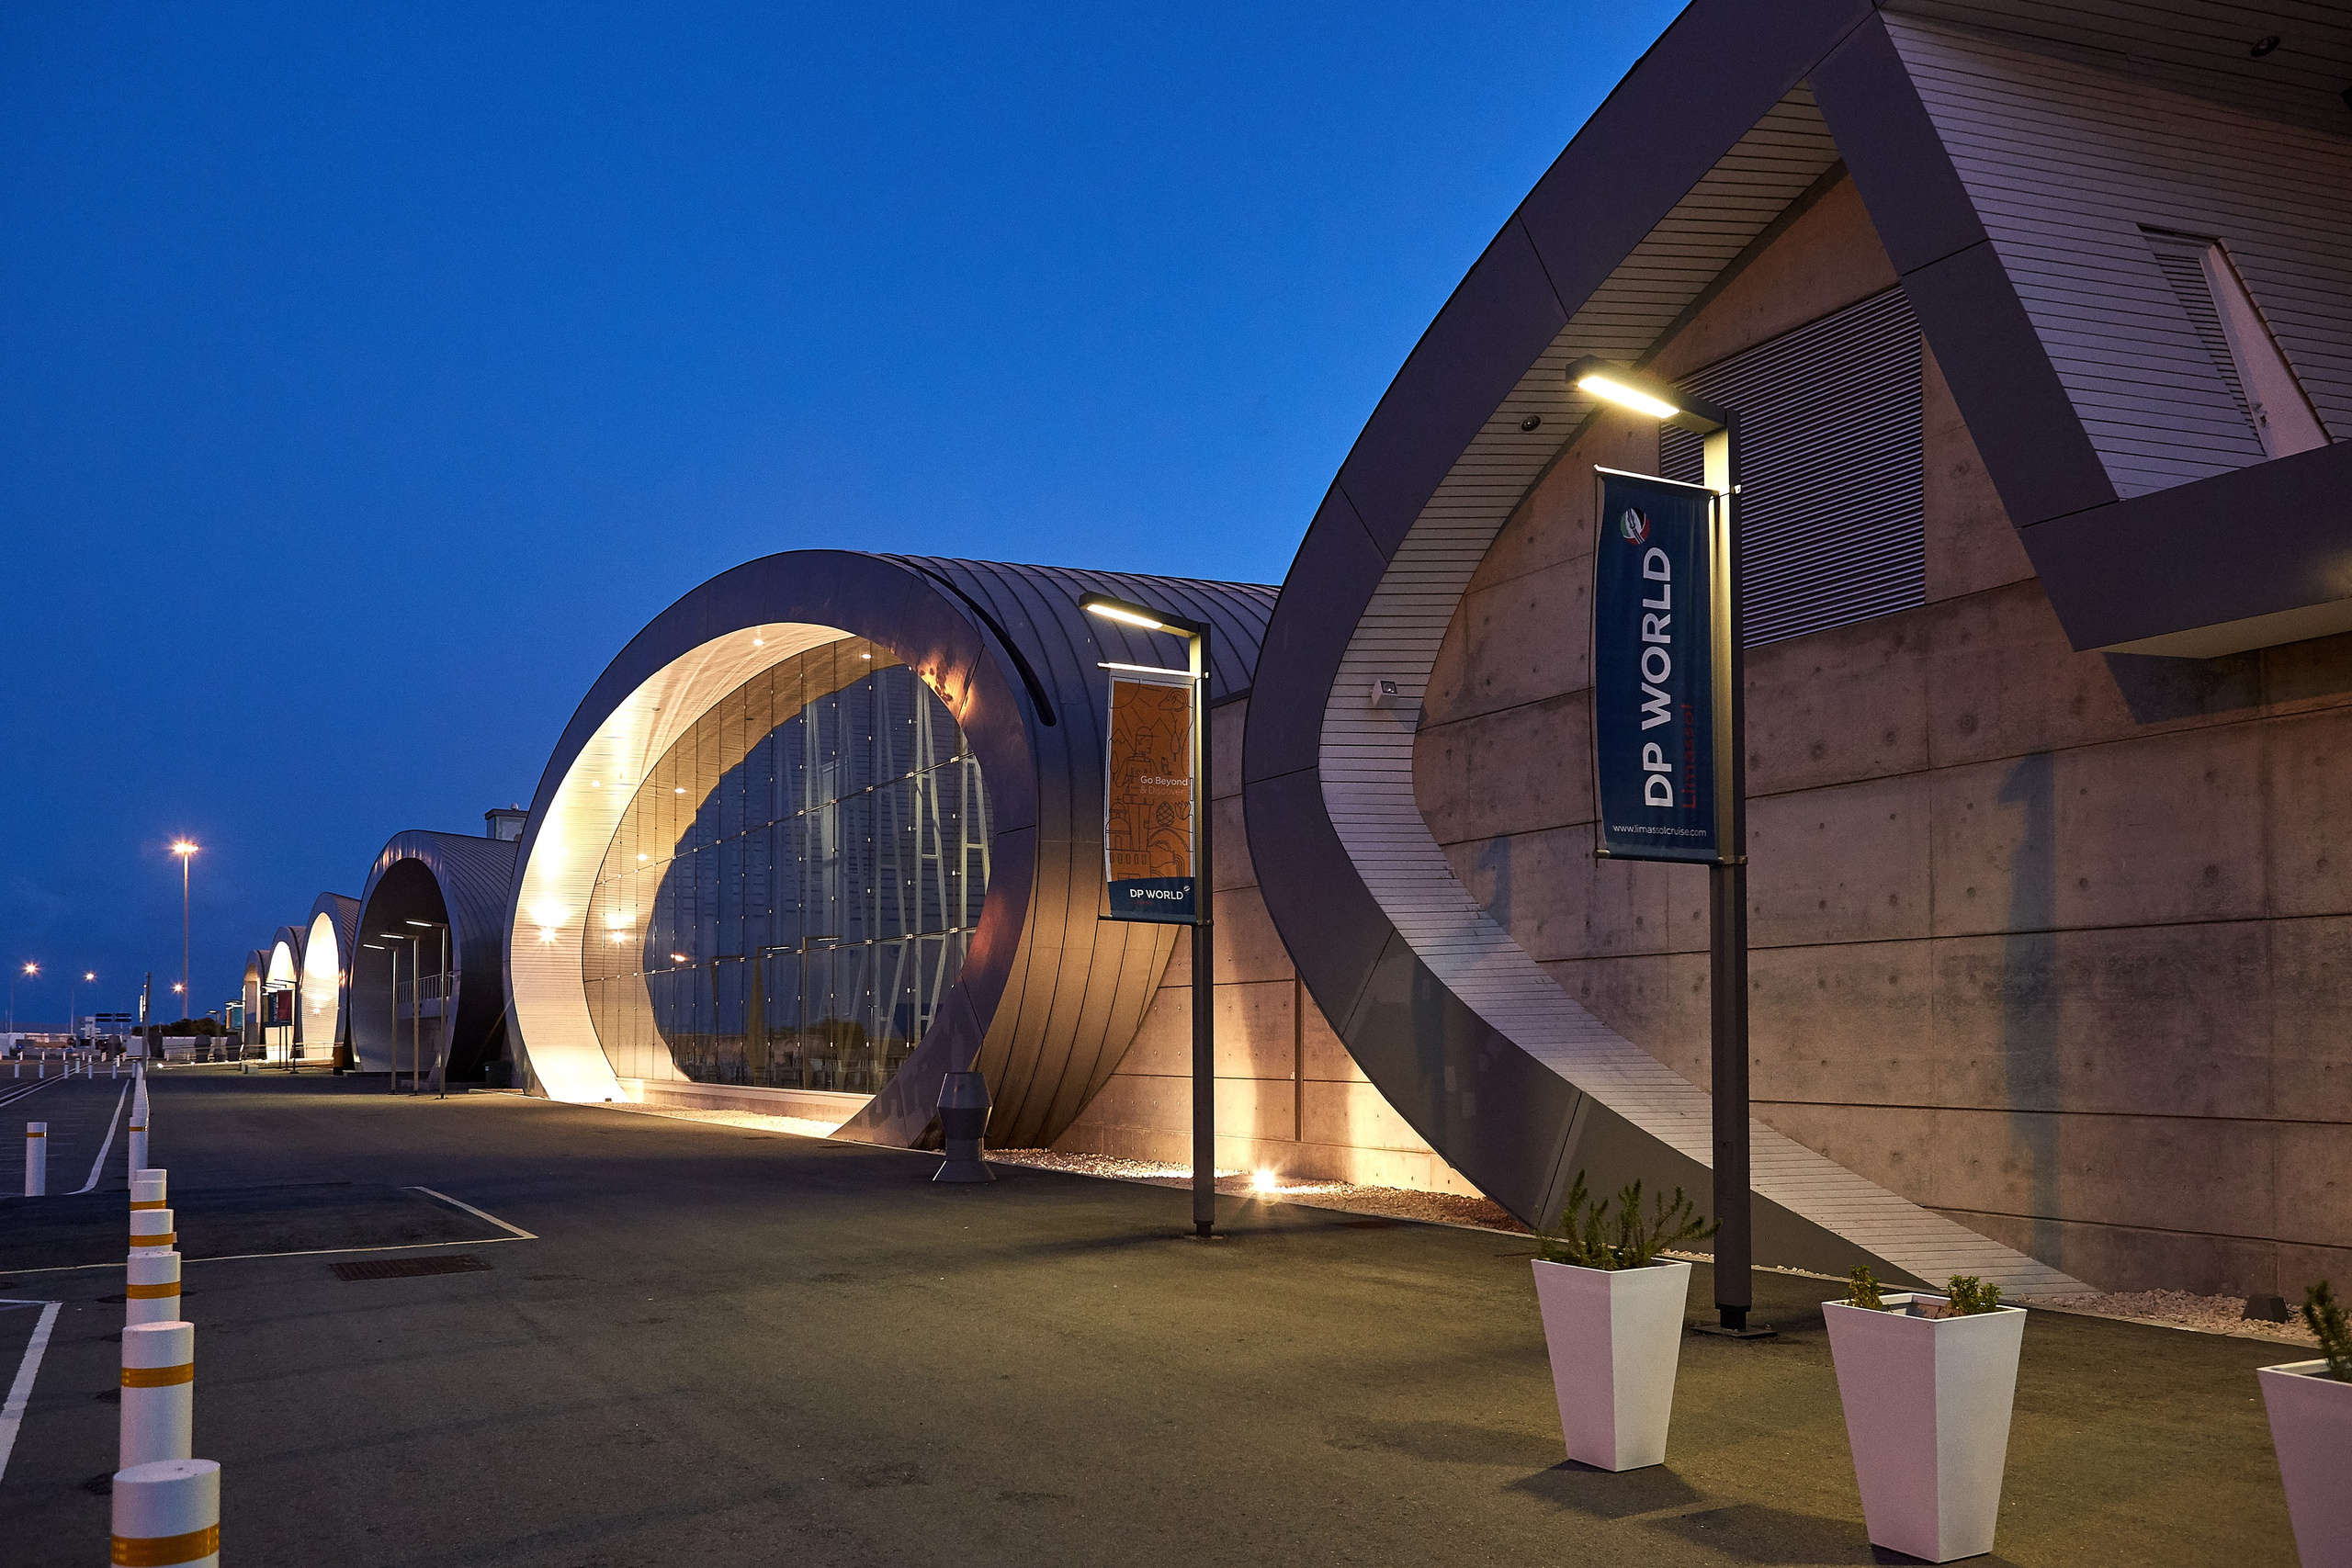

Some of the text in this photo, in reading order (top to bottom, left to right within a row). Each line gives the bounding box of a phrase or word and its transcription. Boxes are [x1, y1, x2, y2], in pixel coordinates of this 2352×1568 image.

[1641, 547, 1674, 807] DP WORLD
[1140, 775, 1188, 787] Go Beyond
[1148, 785, 1184, 796] Discover
[1612, 824, 1707, 837] www.limassolcruise.com
[1129, 888, 1184, 900] DP WORLD
